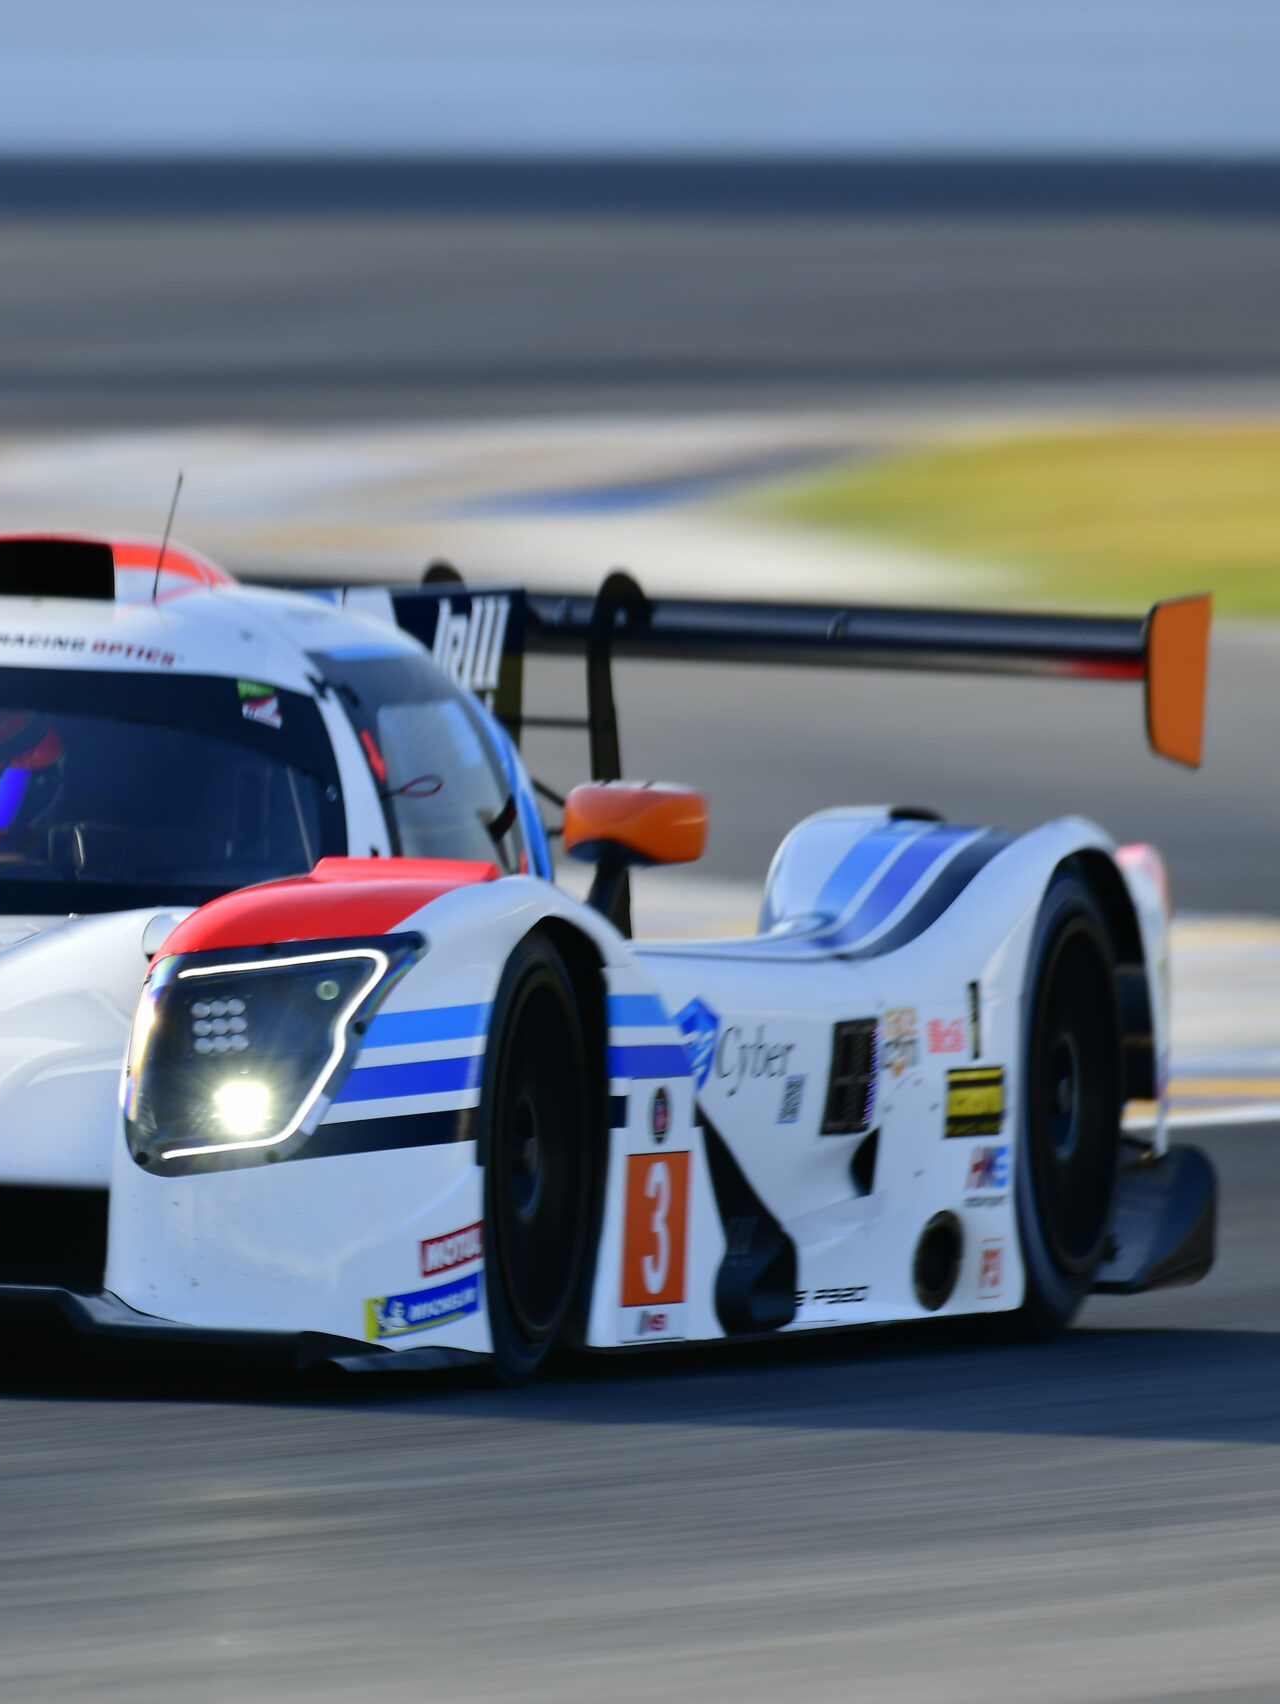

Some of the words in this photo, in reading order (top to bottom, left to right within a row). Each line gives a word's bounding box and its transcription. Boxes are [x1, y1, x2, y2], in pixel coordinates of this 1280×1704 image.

[91, 641, 176, 667] OPTICS
[714, 1024, 796, 1098] Cyber
[641, 1160, 671, 1295] 3
[408, 1287, 477, 1321] MICHELIN
